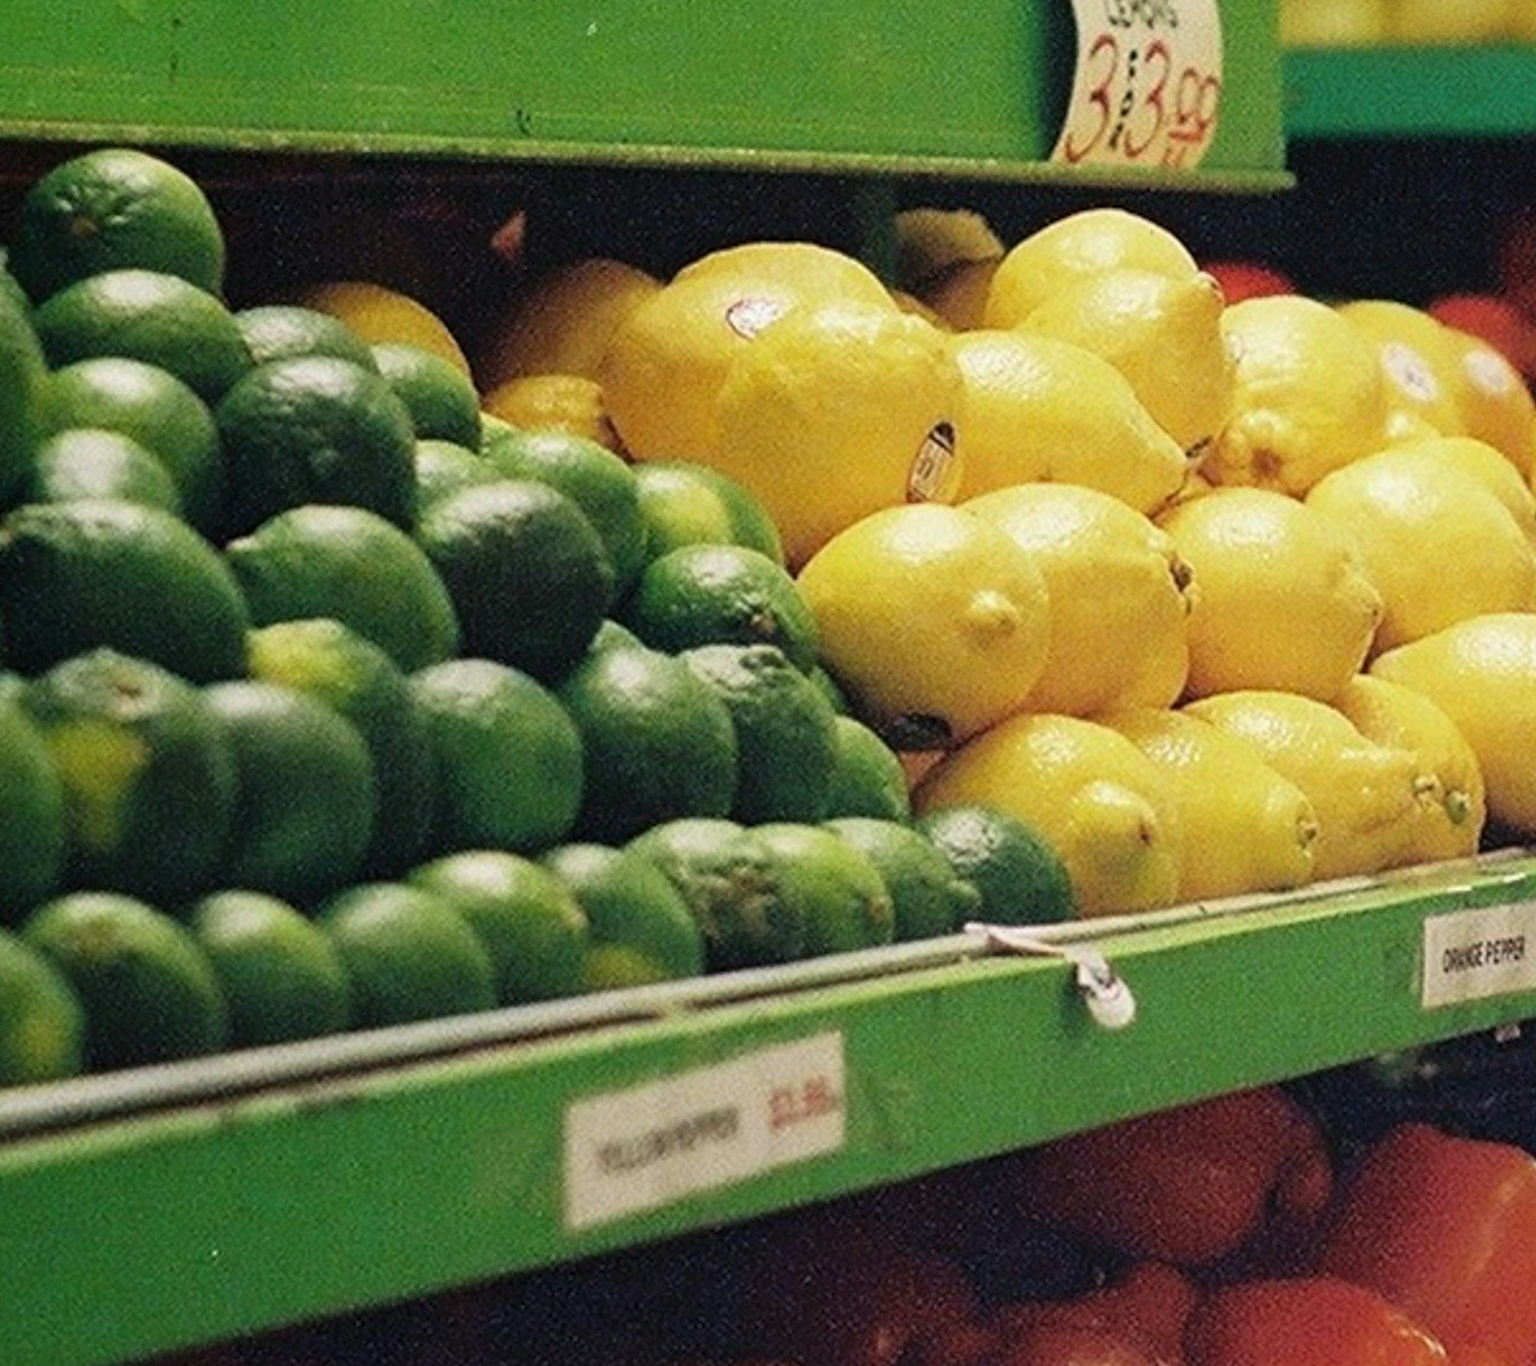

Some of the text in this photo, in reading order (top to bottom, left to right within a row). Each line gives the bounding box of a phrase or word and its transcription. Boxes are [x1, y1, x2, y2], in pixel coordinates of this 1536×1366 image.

[1065, 33, 1120, 164] 3
[1442, 940, 1486, 974] ORANGE
[1486, 935, 1527, 967] PEPPER
